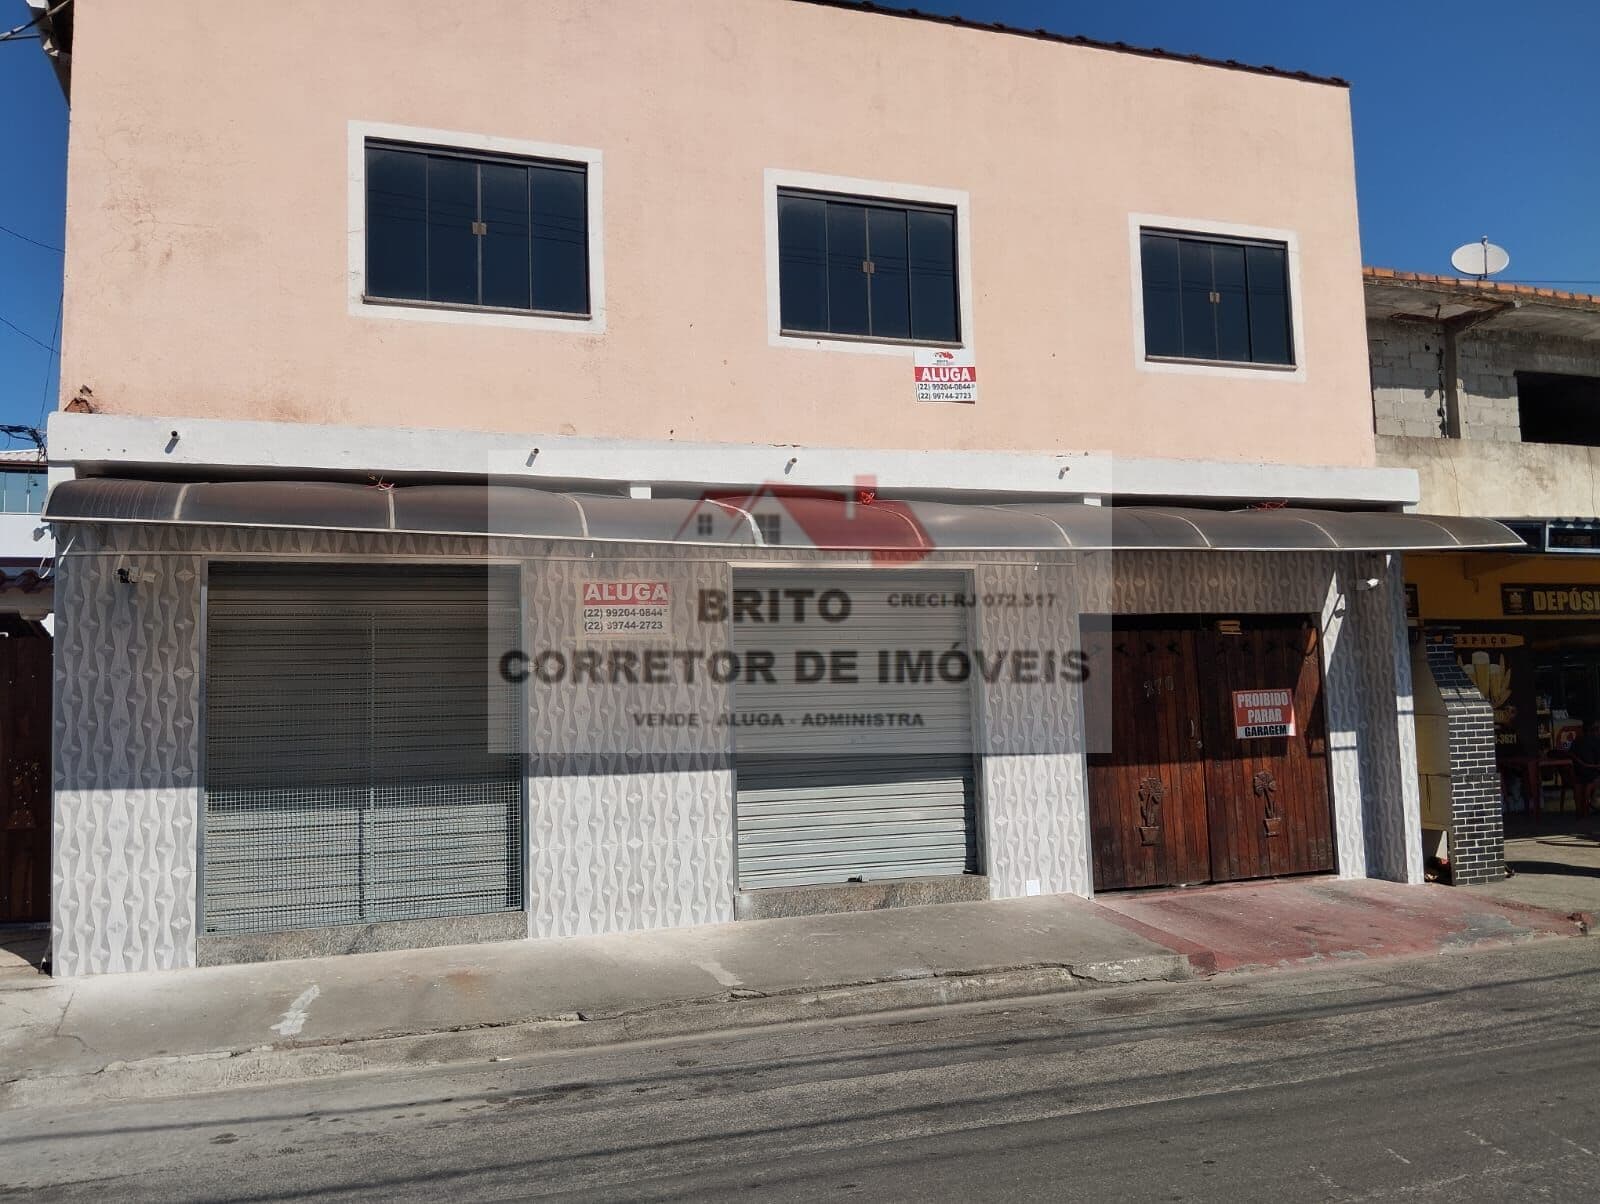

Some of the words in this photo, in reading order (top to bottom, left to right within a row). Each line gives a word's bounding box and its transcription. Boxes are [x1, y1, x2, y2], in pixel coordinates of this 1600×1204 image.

[921, 367, 972, 382] ALUGA
[917, 383, 930, 391] (22)
[932, 392, 972, 400] 99744-2723
[584, 583, 668, 601] ALUGA
[583, 608, 603, 619] (22)
[606, 608, 663, 617] 99204-0844
[584, 621, 603, 632] (22)
[606, 621, 663, 630] 99744-2723
[1237, 691, 1288, 708] PROIBIDO
[1247, 708, 1282, 723] PARAR
[1244, 725, 1288, 737] GARAGEM
